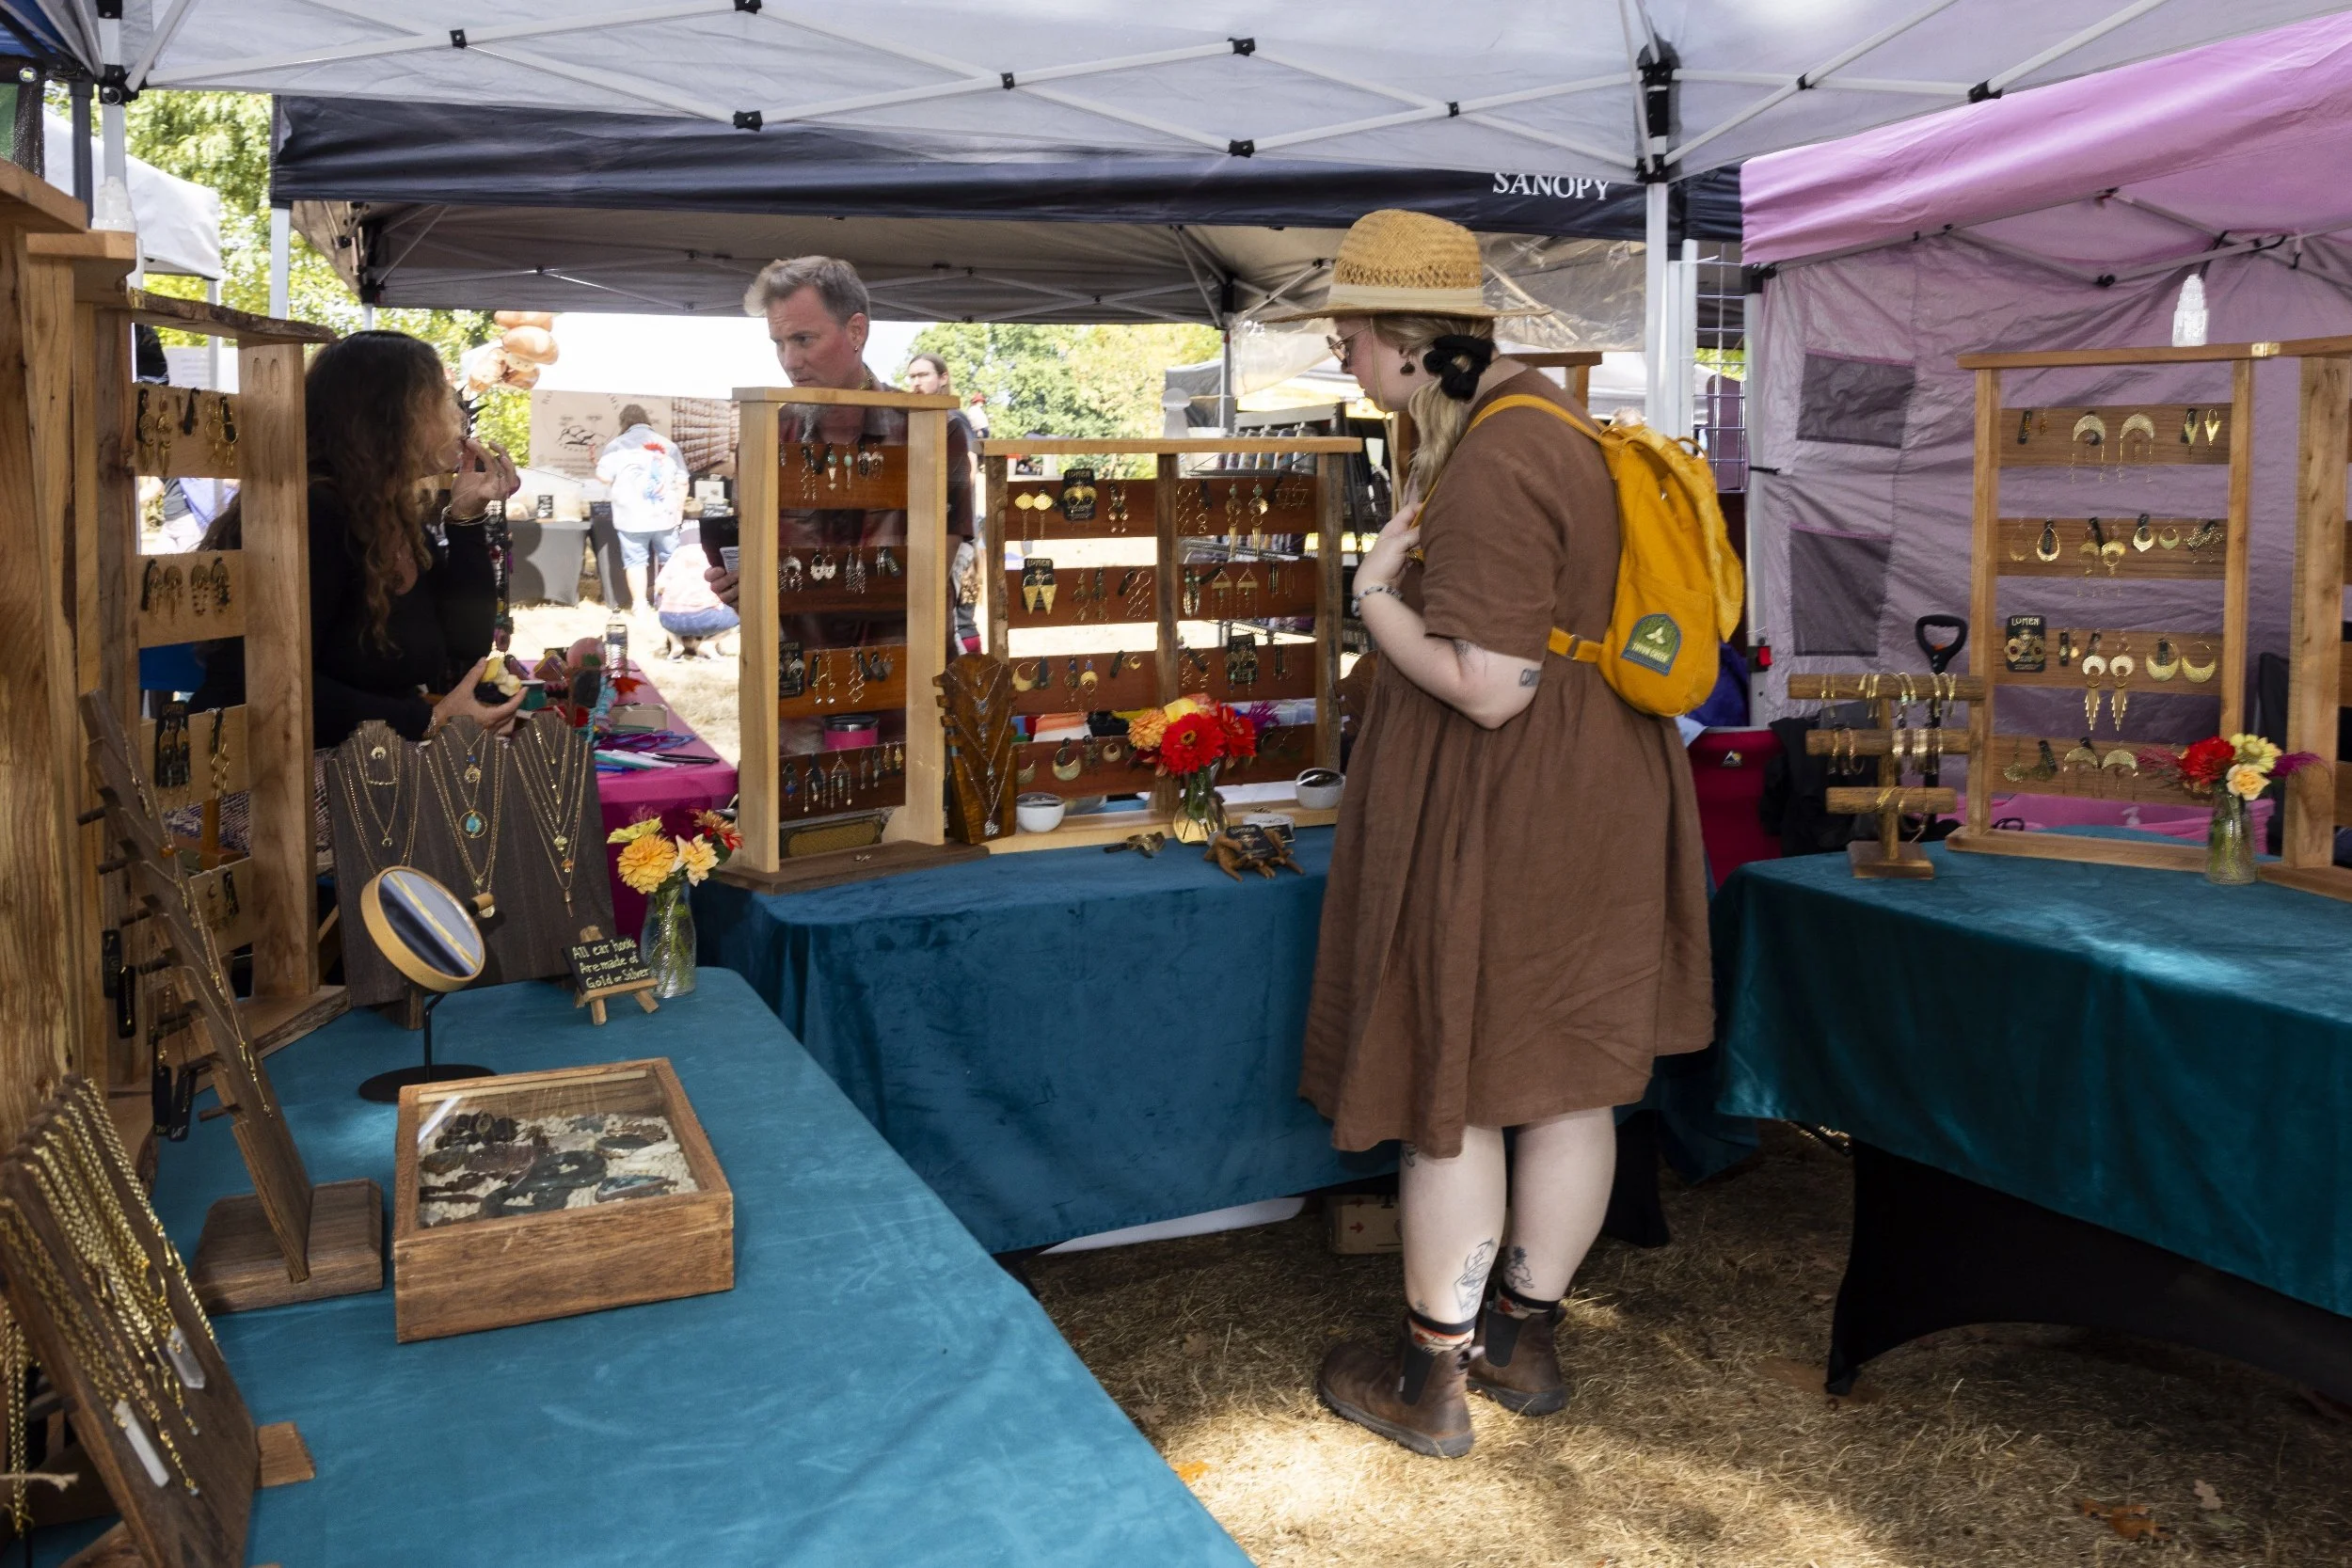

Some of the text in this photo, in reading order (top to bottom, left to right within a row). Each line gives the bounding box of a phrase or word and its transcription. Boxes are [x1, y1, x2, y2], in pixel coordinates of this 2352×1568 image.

[1492, 171, 1610, 200] SANOPY
[572, 946, 590, 959] All
[579, 961, 601, 974] Are
[600, 954, 628, 971] made
[585, 974, 614, 989] Gold
[621, 967, 650, 981] Silver
